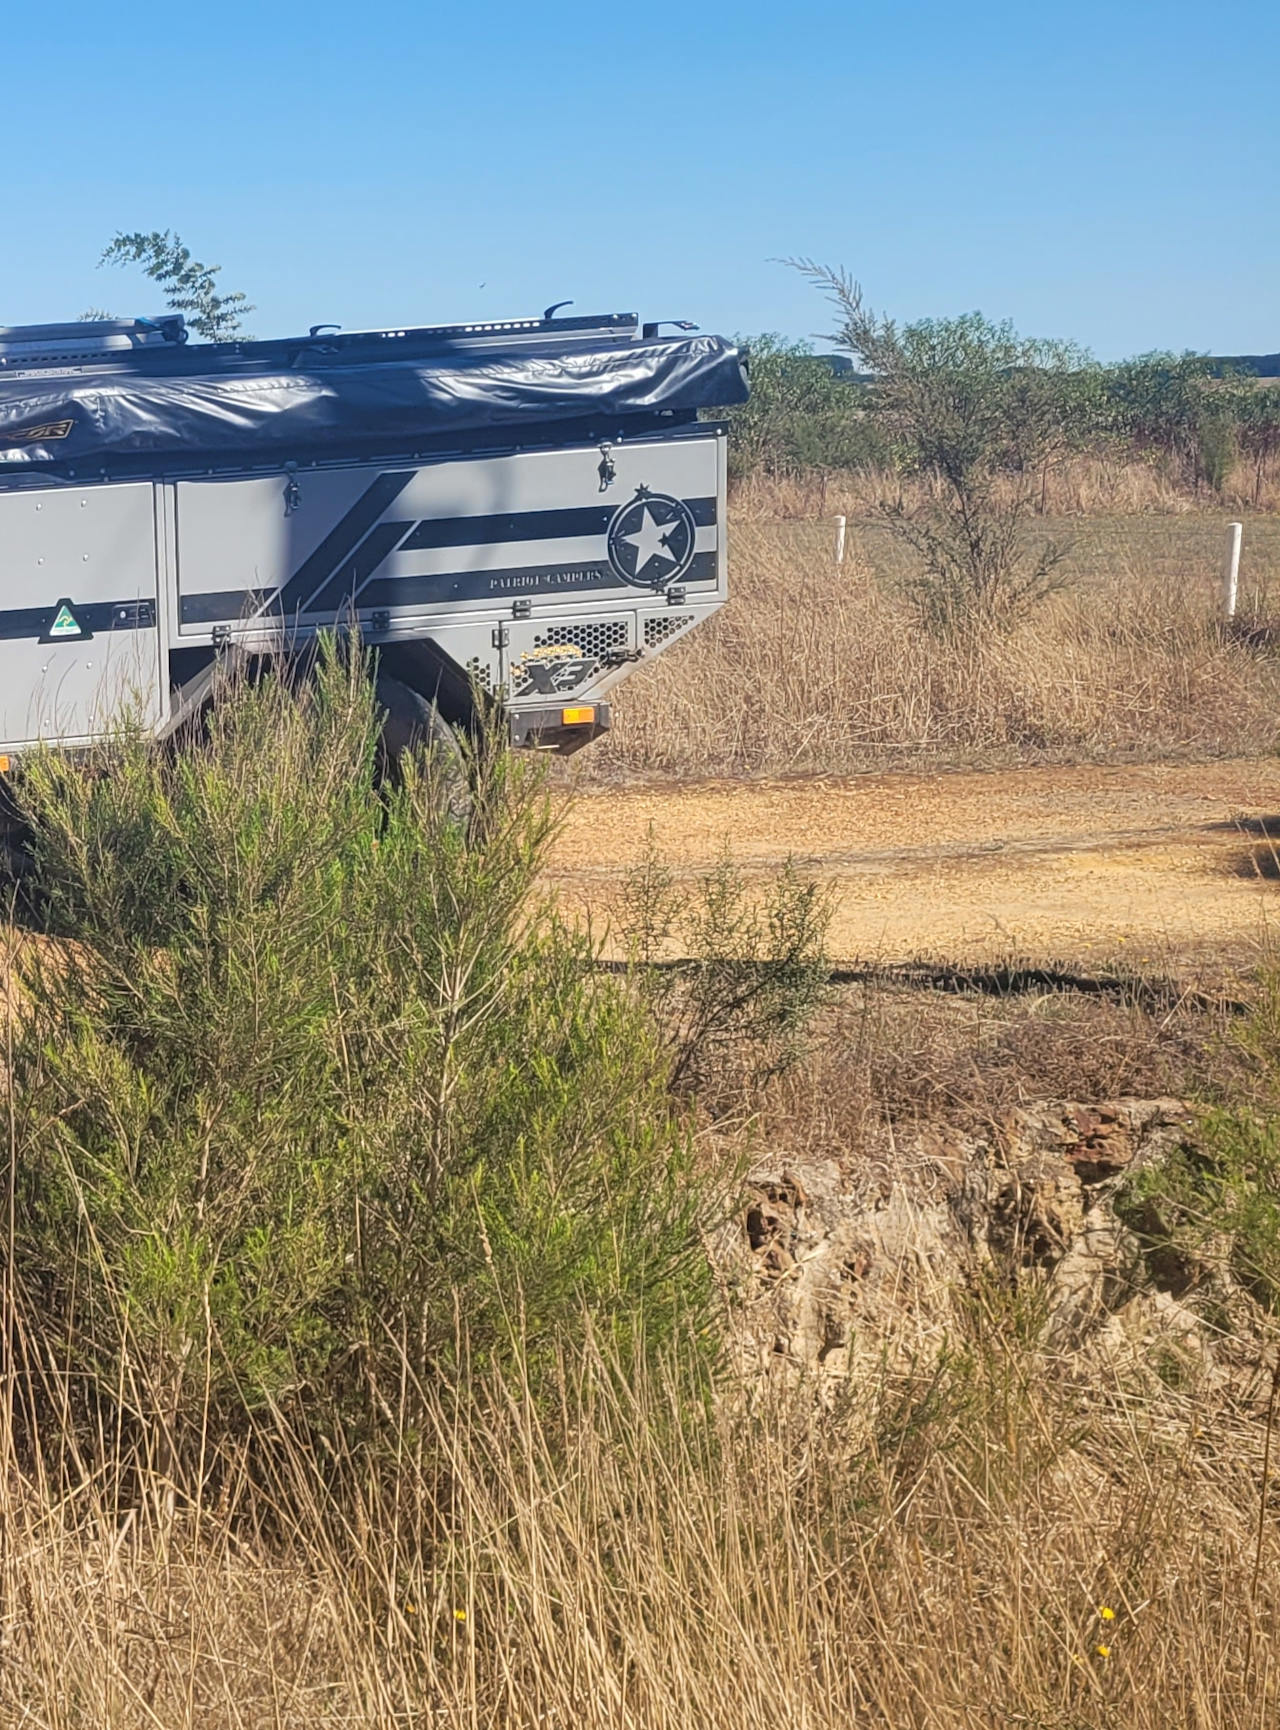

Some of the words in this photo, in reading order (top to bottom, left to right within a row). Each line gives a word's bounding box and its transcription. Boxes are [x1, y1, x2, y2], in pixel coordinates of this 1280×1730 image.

[489, 576, 540, 589] PATRIOT
[544, 570, 603, 585] CAMPERS
[513, 660, 597, 697] X3
